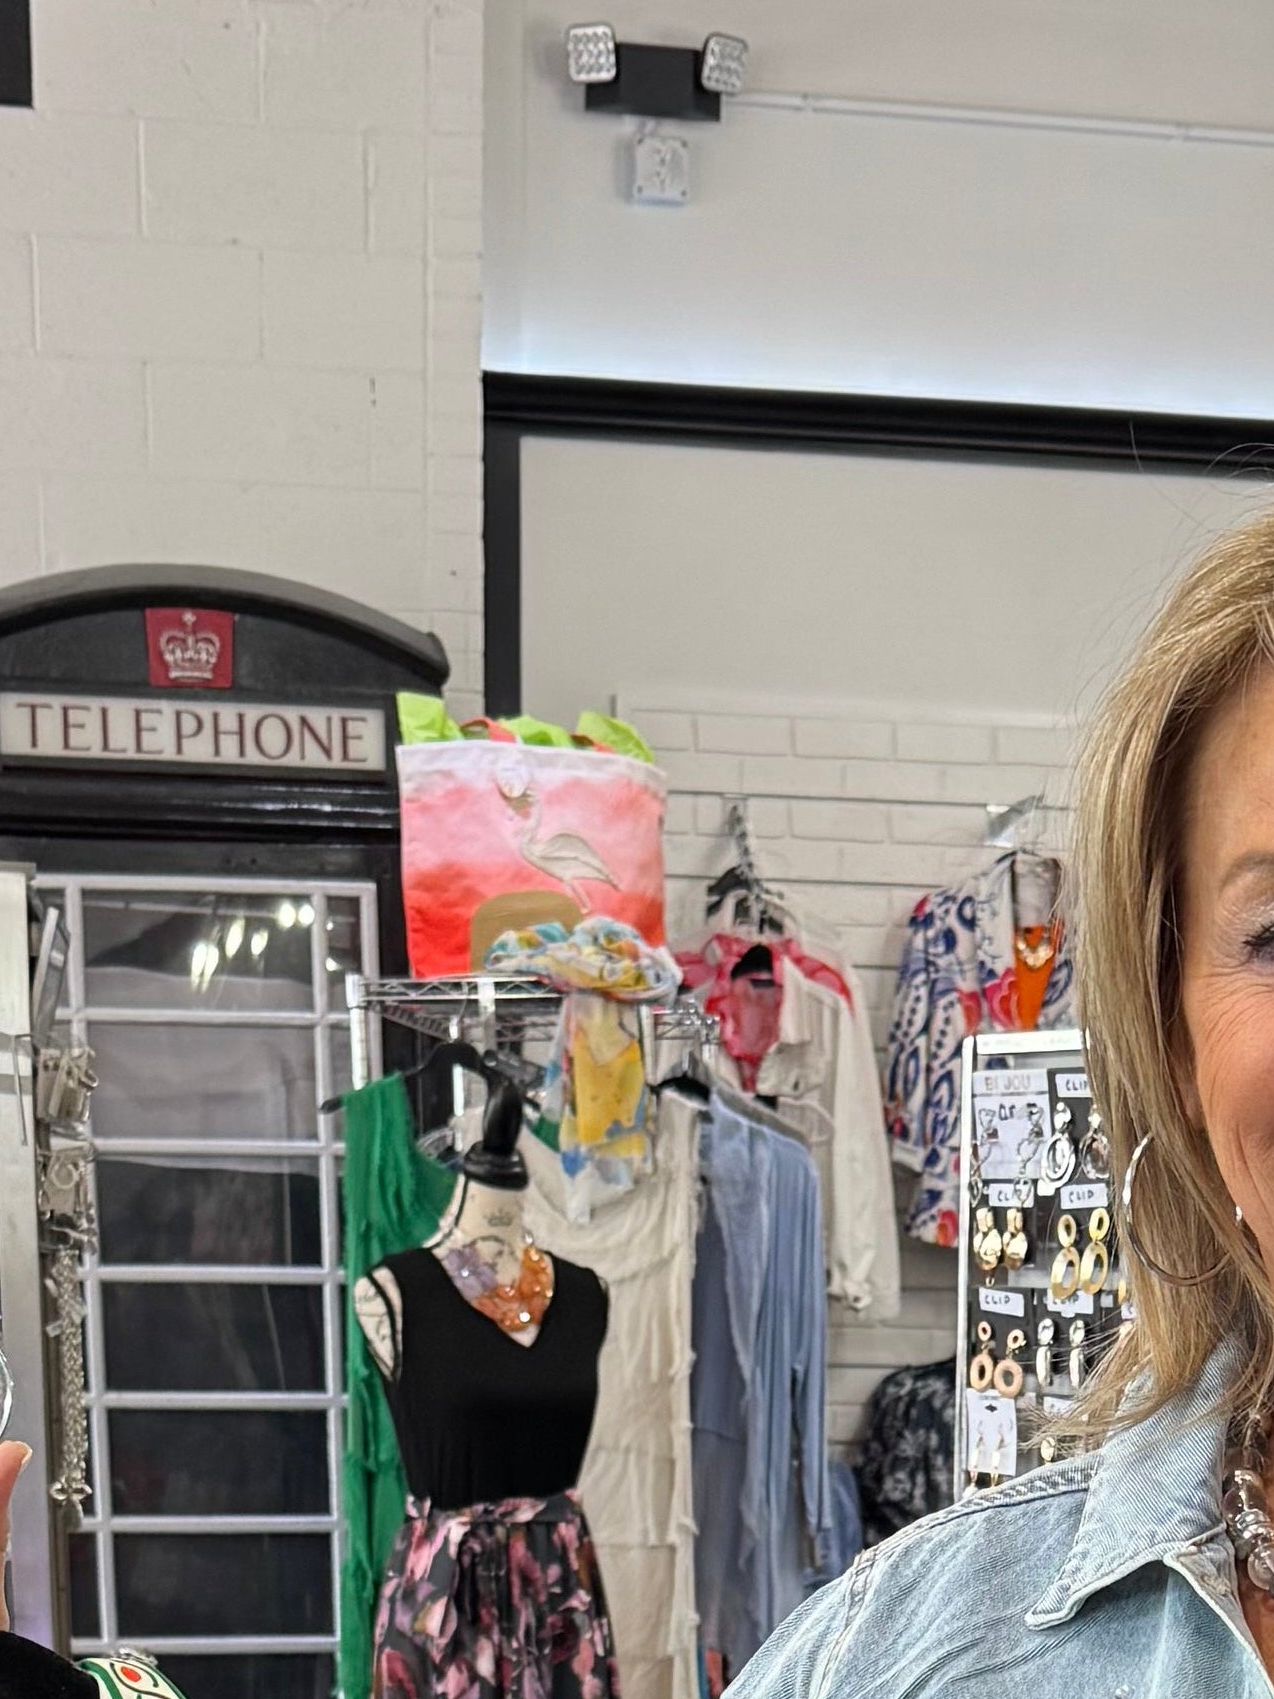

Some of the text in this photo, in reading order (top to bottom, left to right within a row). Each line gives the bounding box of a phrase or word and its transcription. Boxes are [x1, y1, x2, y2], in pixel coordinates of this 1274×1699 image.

[16, 702, 368, 763] TELEPHONE
[1068, 1190, 1094, 1203] CLIP
[985, 1294, 1010, 1305] CLIP
